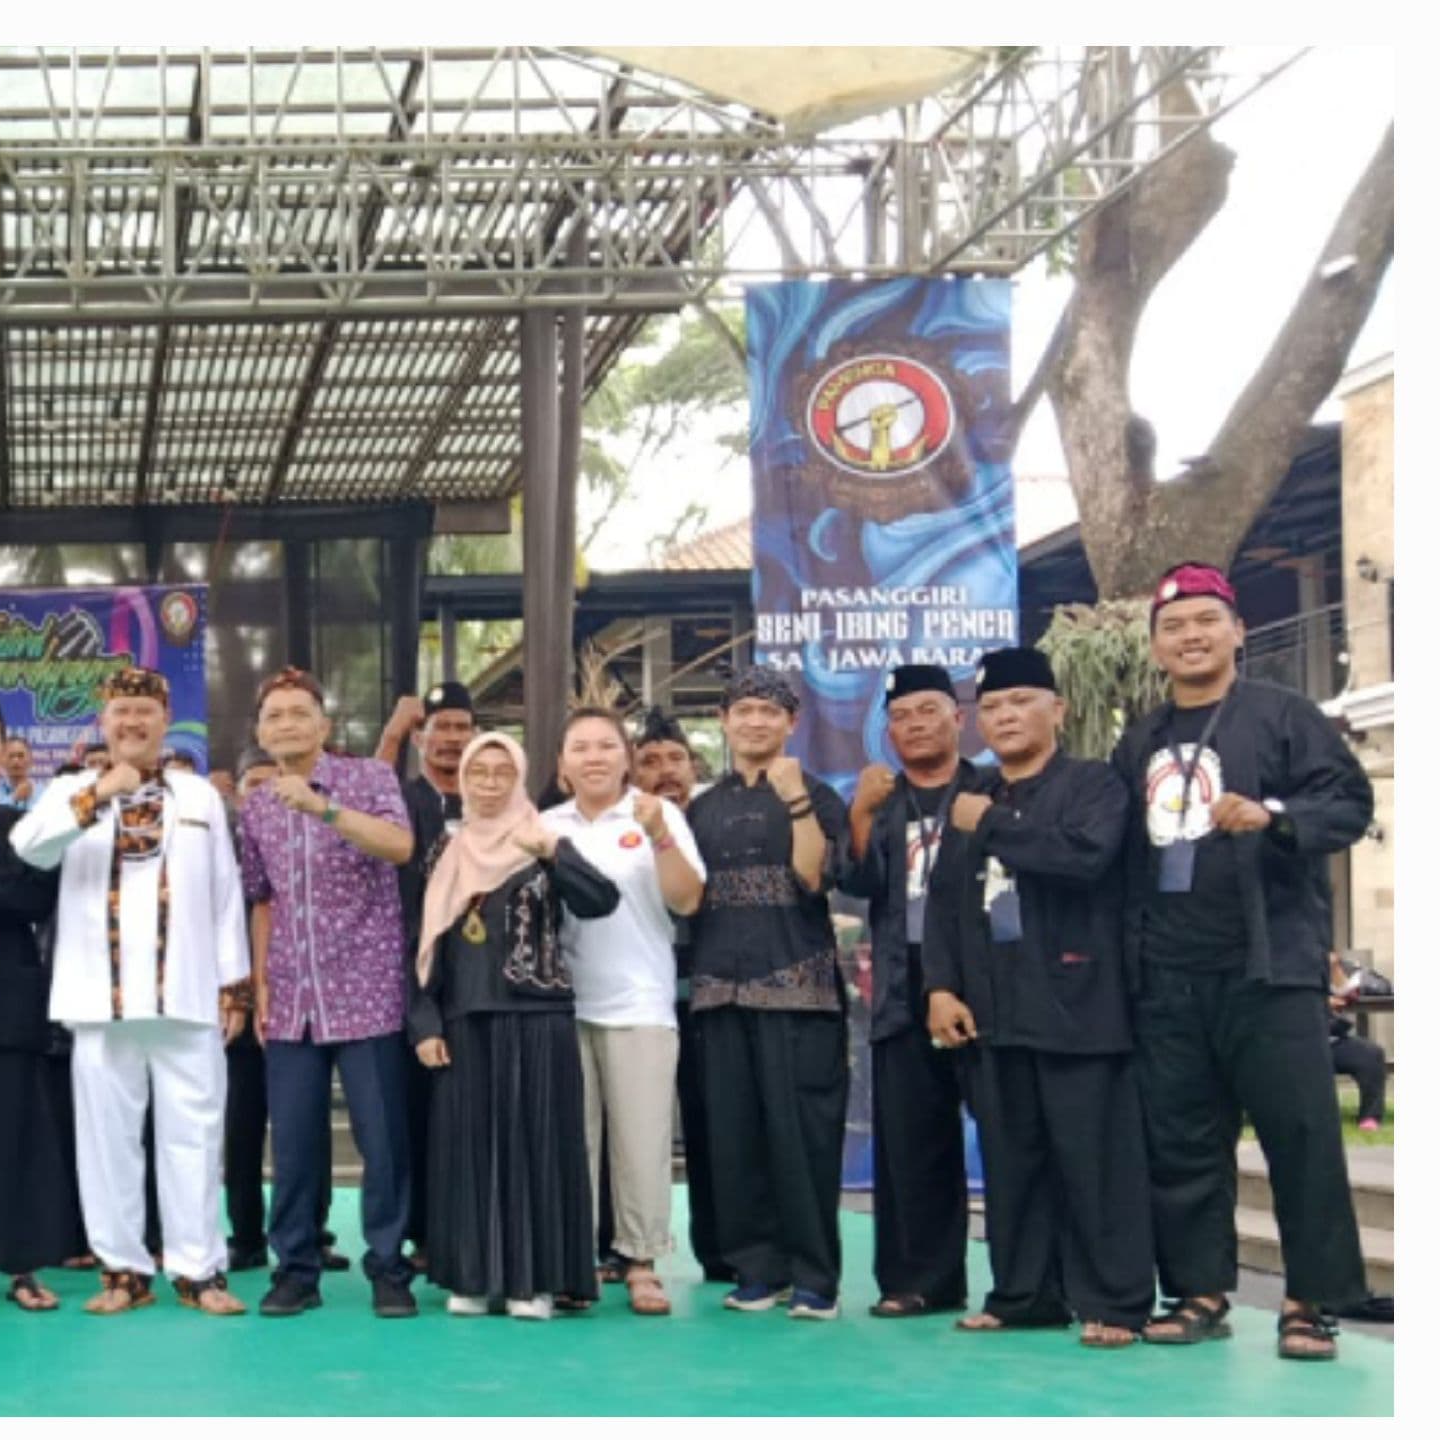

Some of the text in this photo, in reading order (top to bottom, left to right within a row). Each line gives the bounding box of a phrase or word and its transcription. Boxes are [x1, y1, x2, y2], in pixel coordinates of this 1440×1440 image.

[801, 585, 968, 608] PASANGGIRI
[757, 611, 820, 643] SENI
[767, 646, 992, 672] SA JAWA BARA
